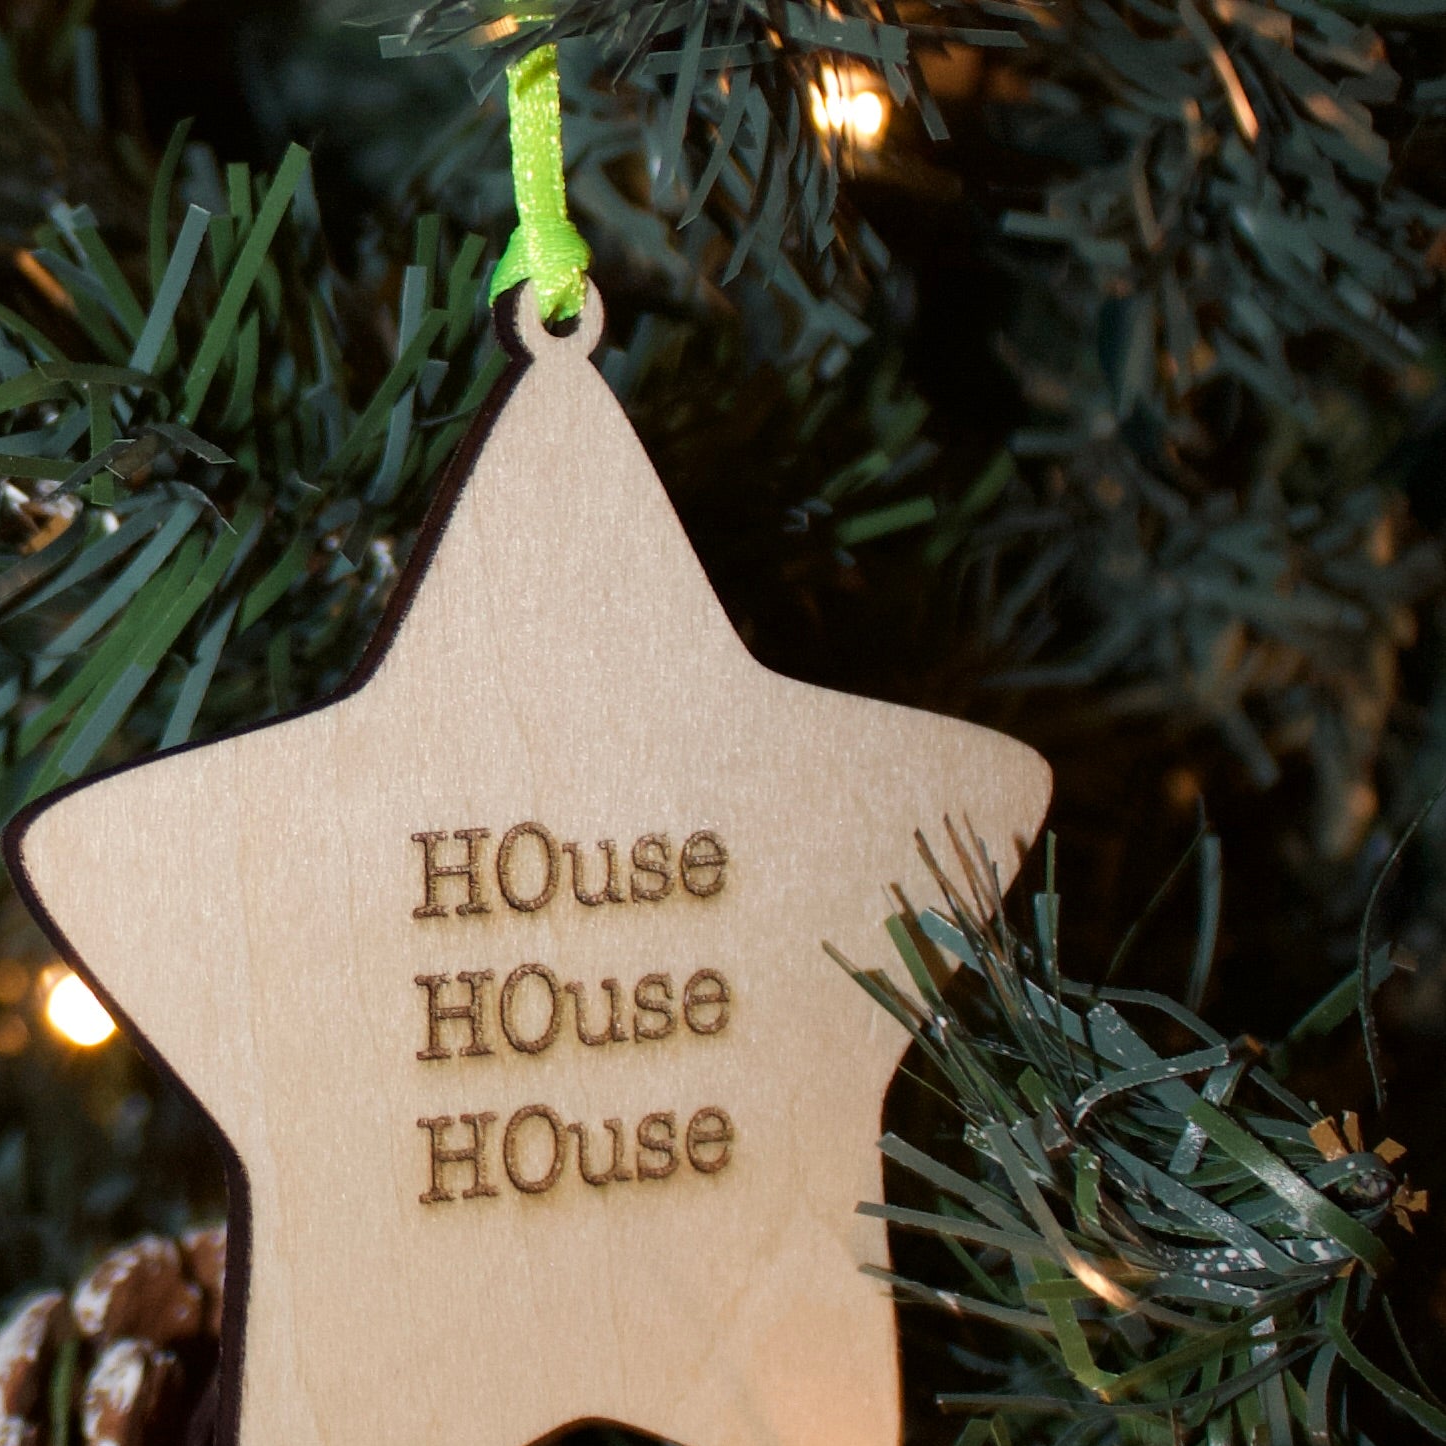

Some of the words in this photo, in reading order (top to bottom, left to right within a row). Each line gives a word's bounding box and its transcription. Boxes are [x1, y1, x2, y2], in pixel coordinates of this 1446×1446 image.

[410, 820, 730, 920] HOuse
[414, 962, 732, 1062] HOuse
[416, 1103, 736, 1205] HOuse
